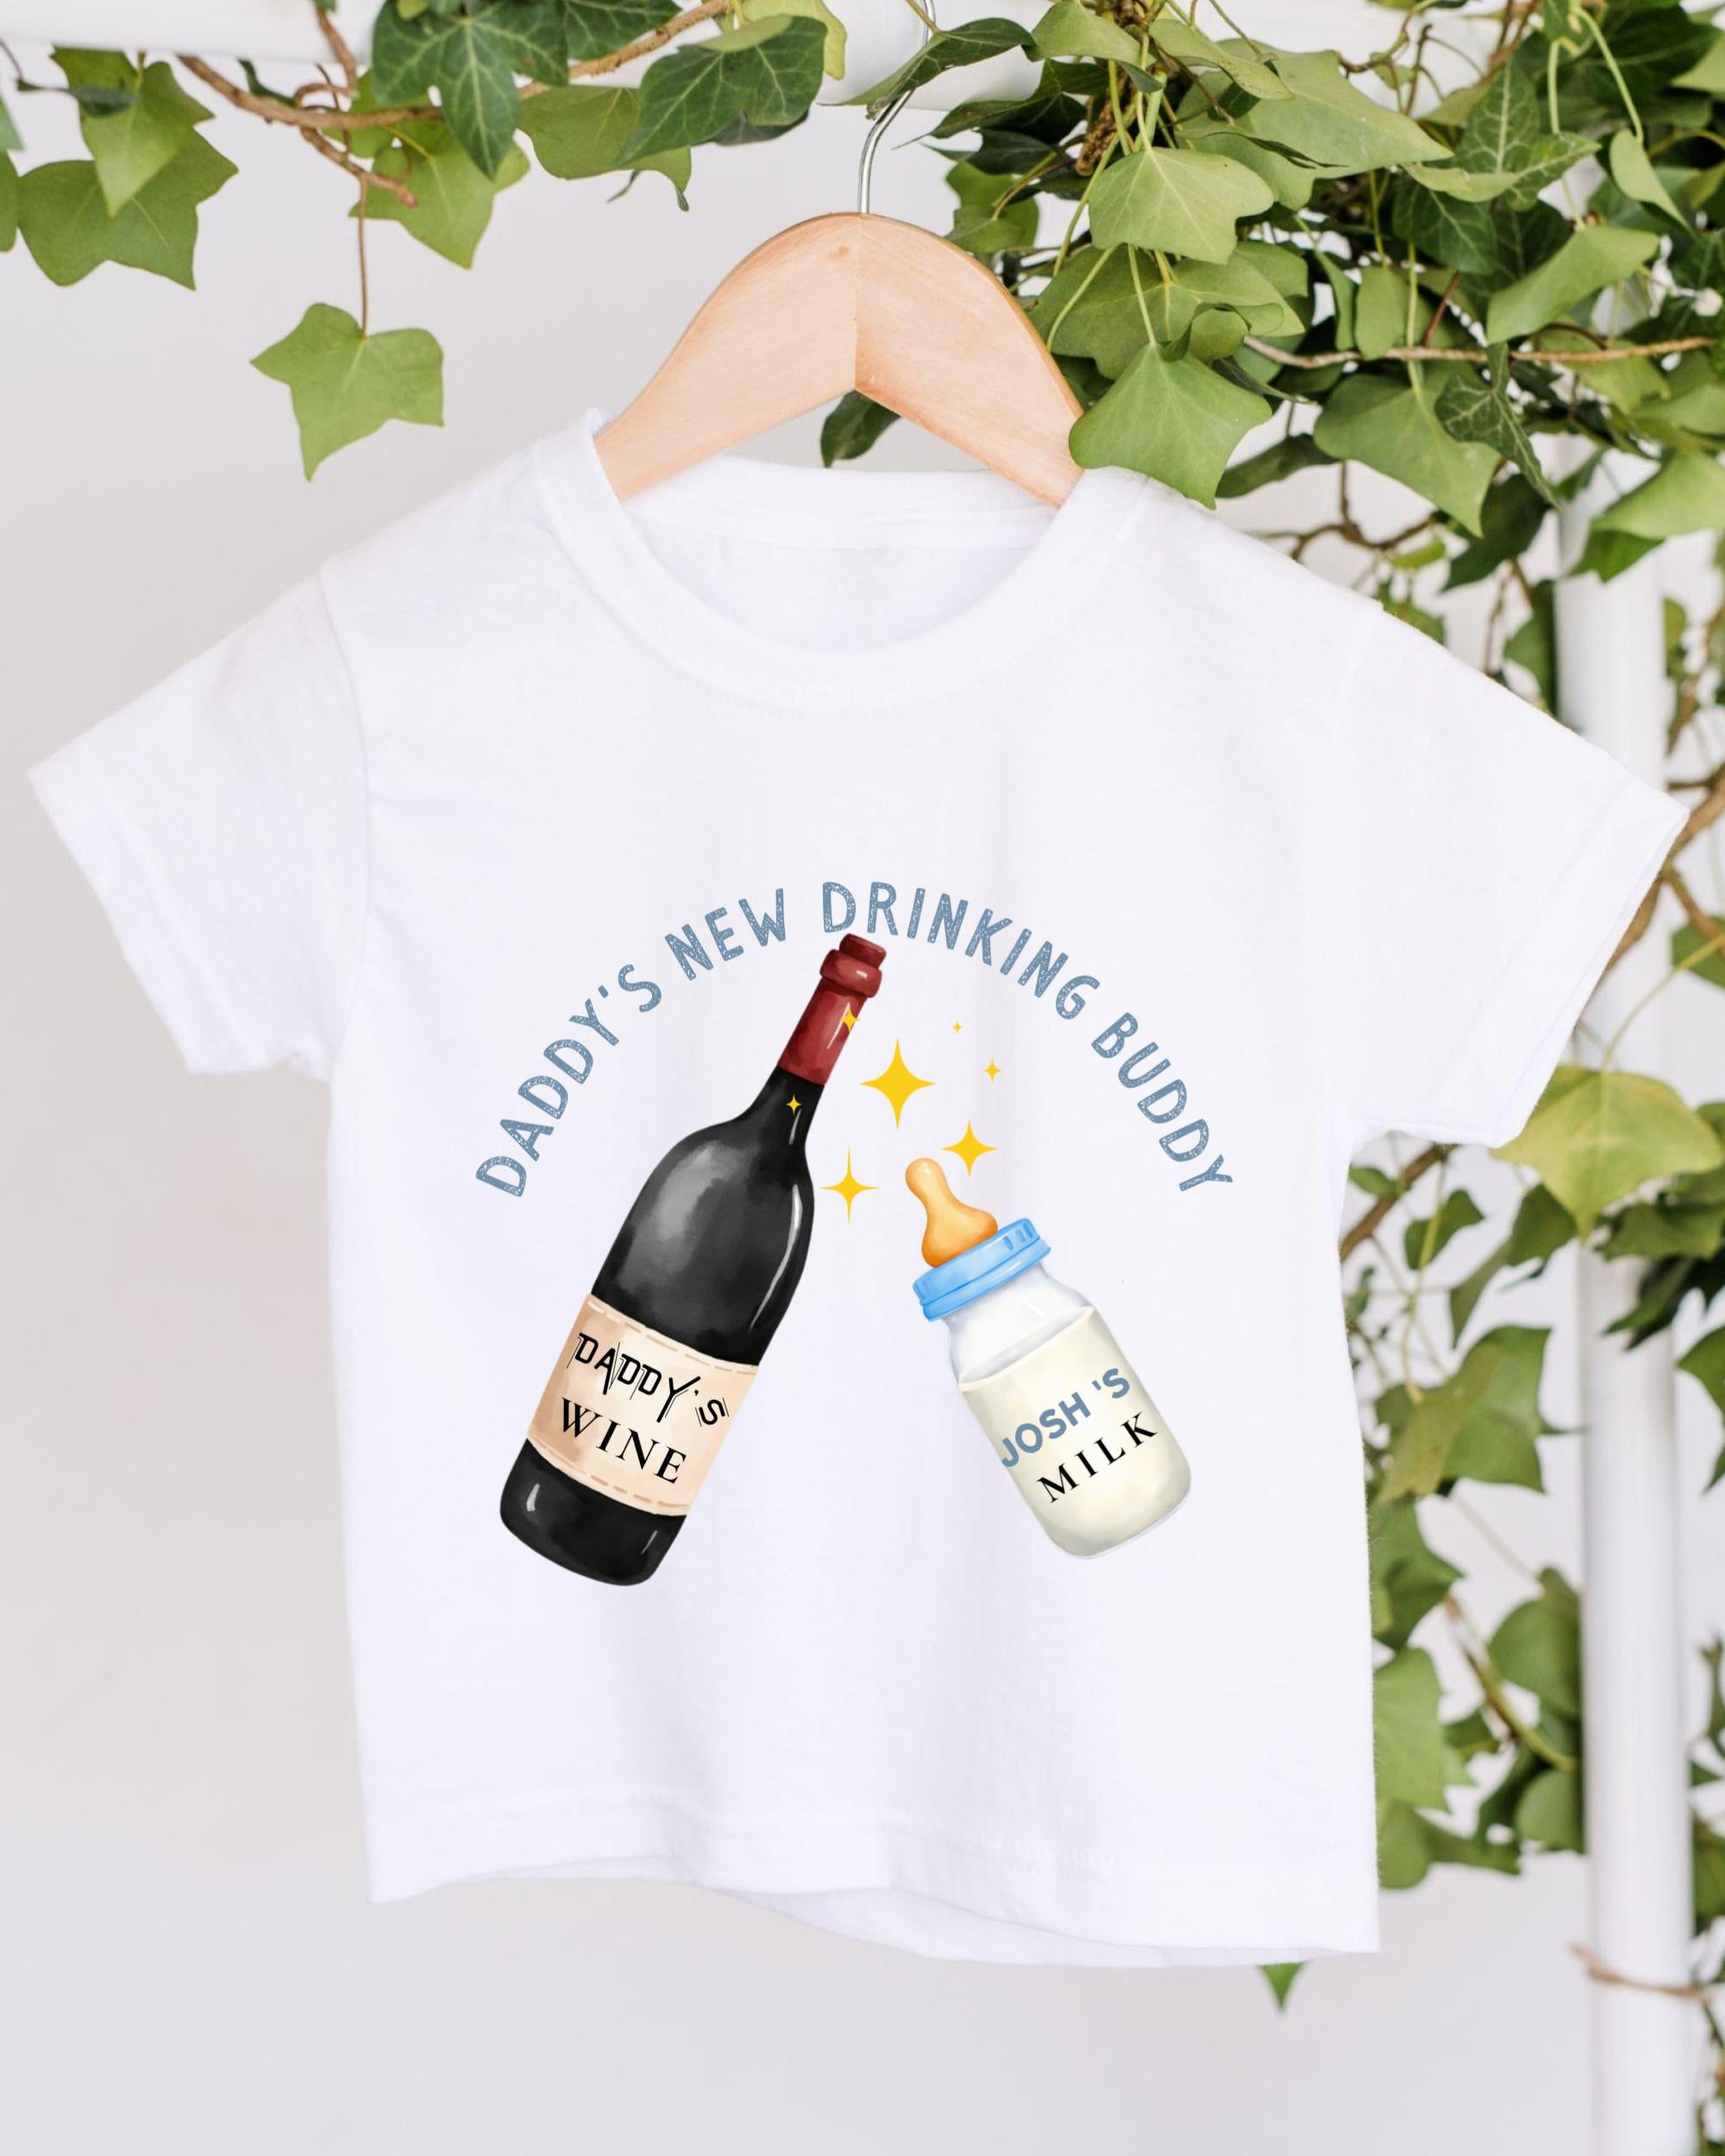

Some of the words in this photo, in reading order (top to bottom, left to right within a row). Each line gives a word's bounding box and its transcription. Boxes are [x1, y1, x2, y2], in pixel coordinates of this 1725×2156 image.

[475, 963, 662, 1198] DADDY'S
[664, 887, 787, 981] NEW
[821, 881, 1101, 1020] DRINKING
[1090, 1012, 1233, 1192] BUDDY
[566, 1332, 730, 1427] DADDY'S
[561, 1396, 687, 1484] WINE
[1036, 1411, 1158, 1504] MILK
